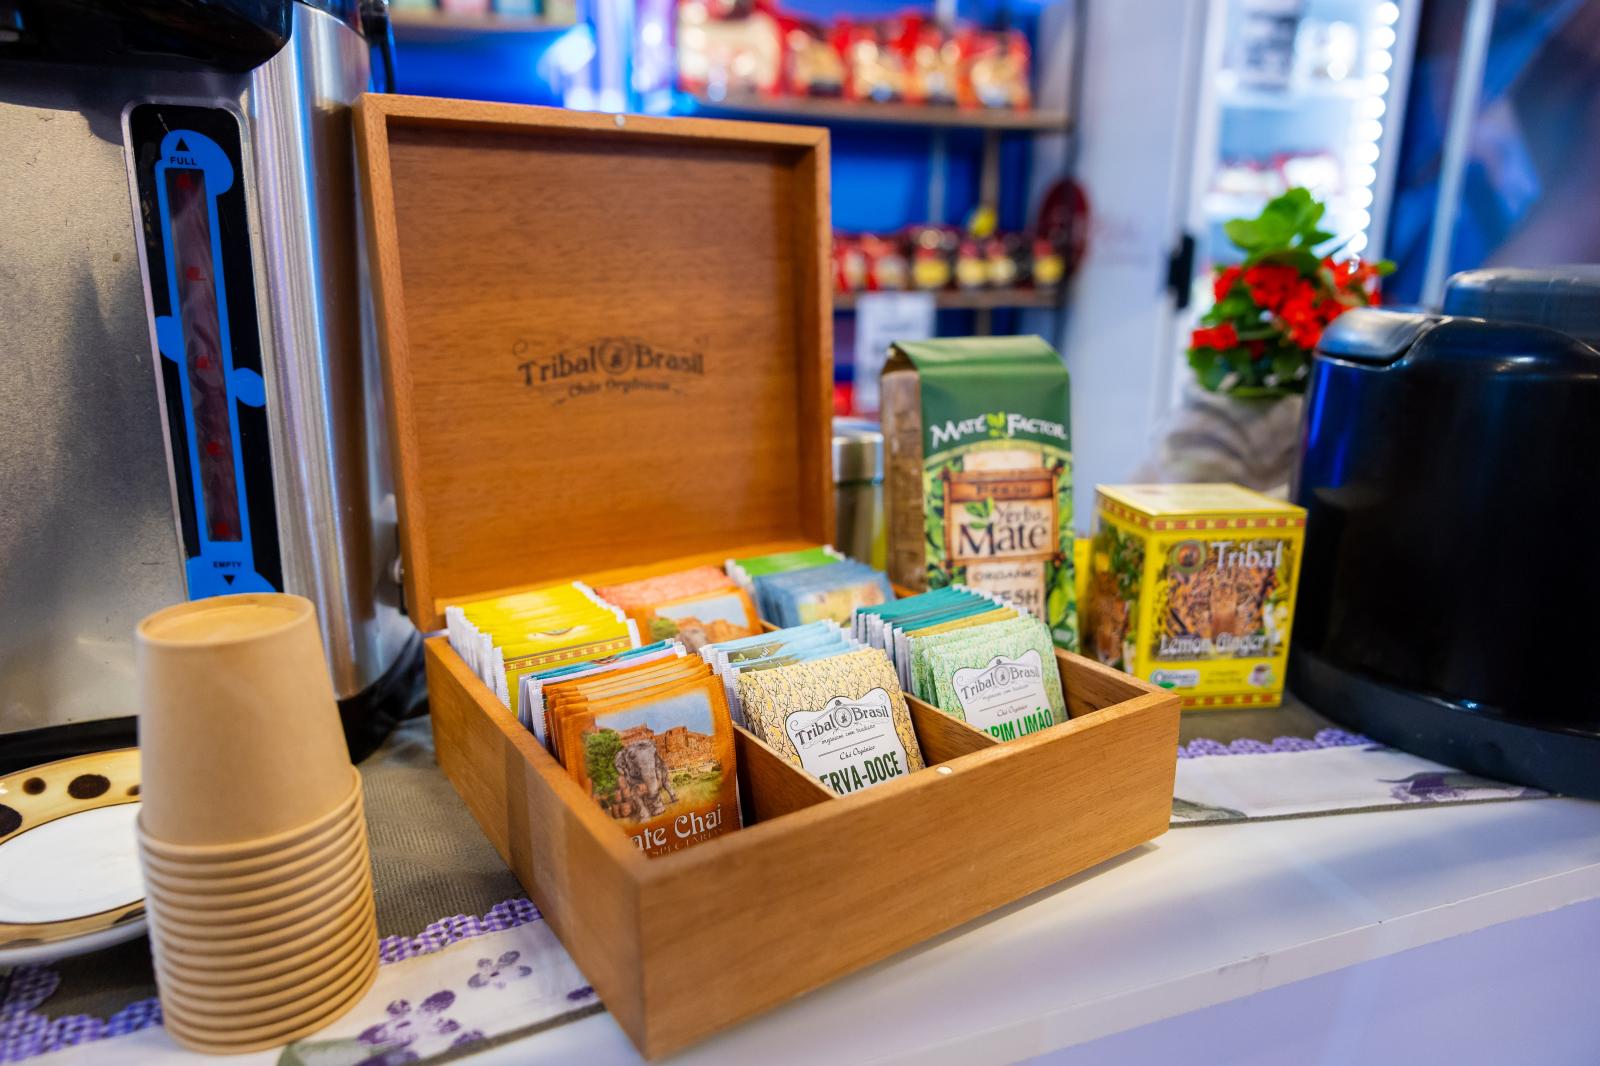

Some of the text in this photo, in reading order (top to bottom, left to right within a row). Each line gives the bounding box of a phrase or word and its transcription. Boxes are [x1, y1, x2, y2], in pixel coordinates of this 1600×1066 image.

[170, 156, 198, 166] FULL
[518, 344, 705, 387] Tribal Brasil
[213, 561, 242, 569] EMPTY
[1211, 541, 1284, 570] Tribal
[961, 672, 996, 700] Tribal
[1009, 666, 1040, 681] Brasil
[794, 705, 890, 746] Tribal Brasil
[1017, 706, 1054, 737] LIMÃO
[632, 803, 723, 852] ate Chai
